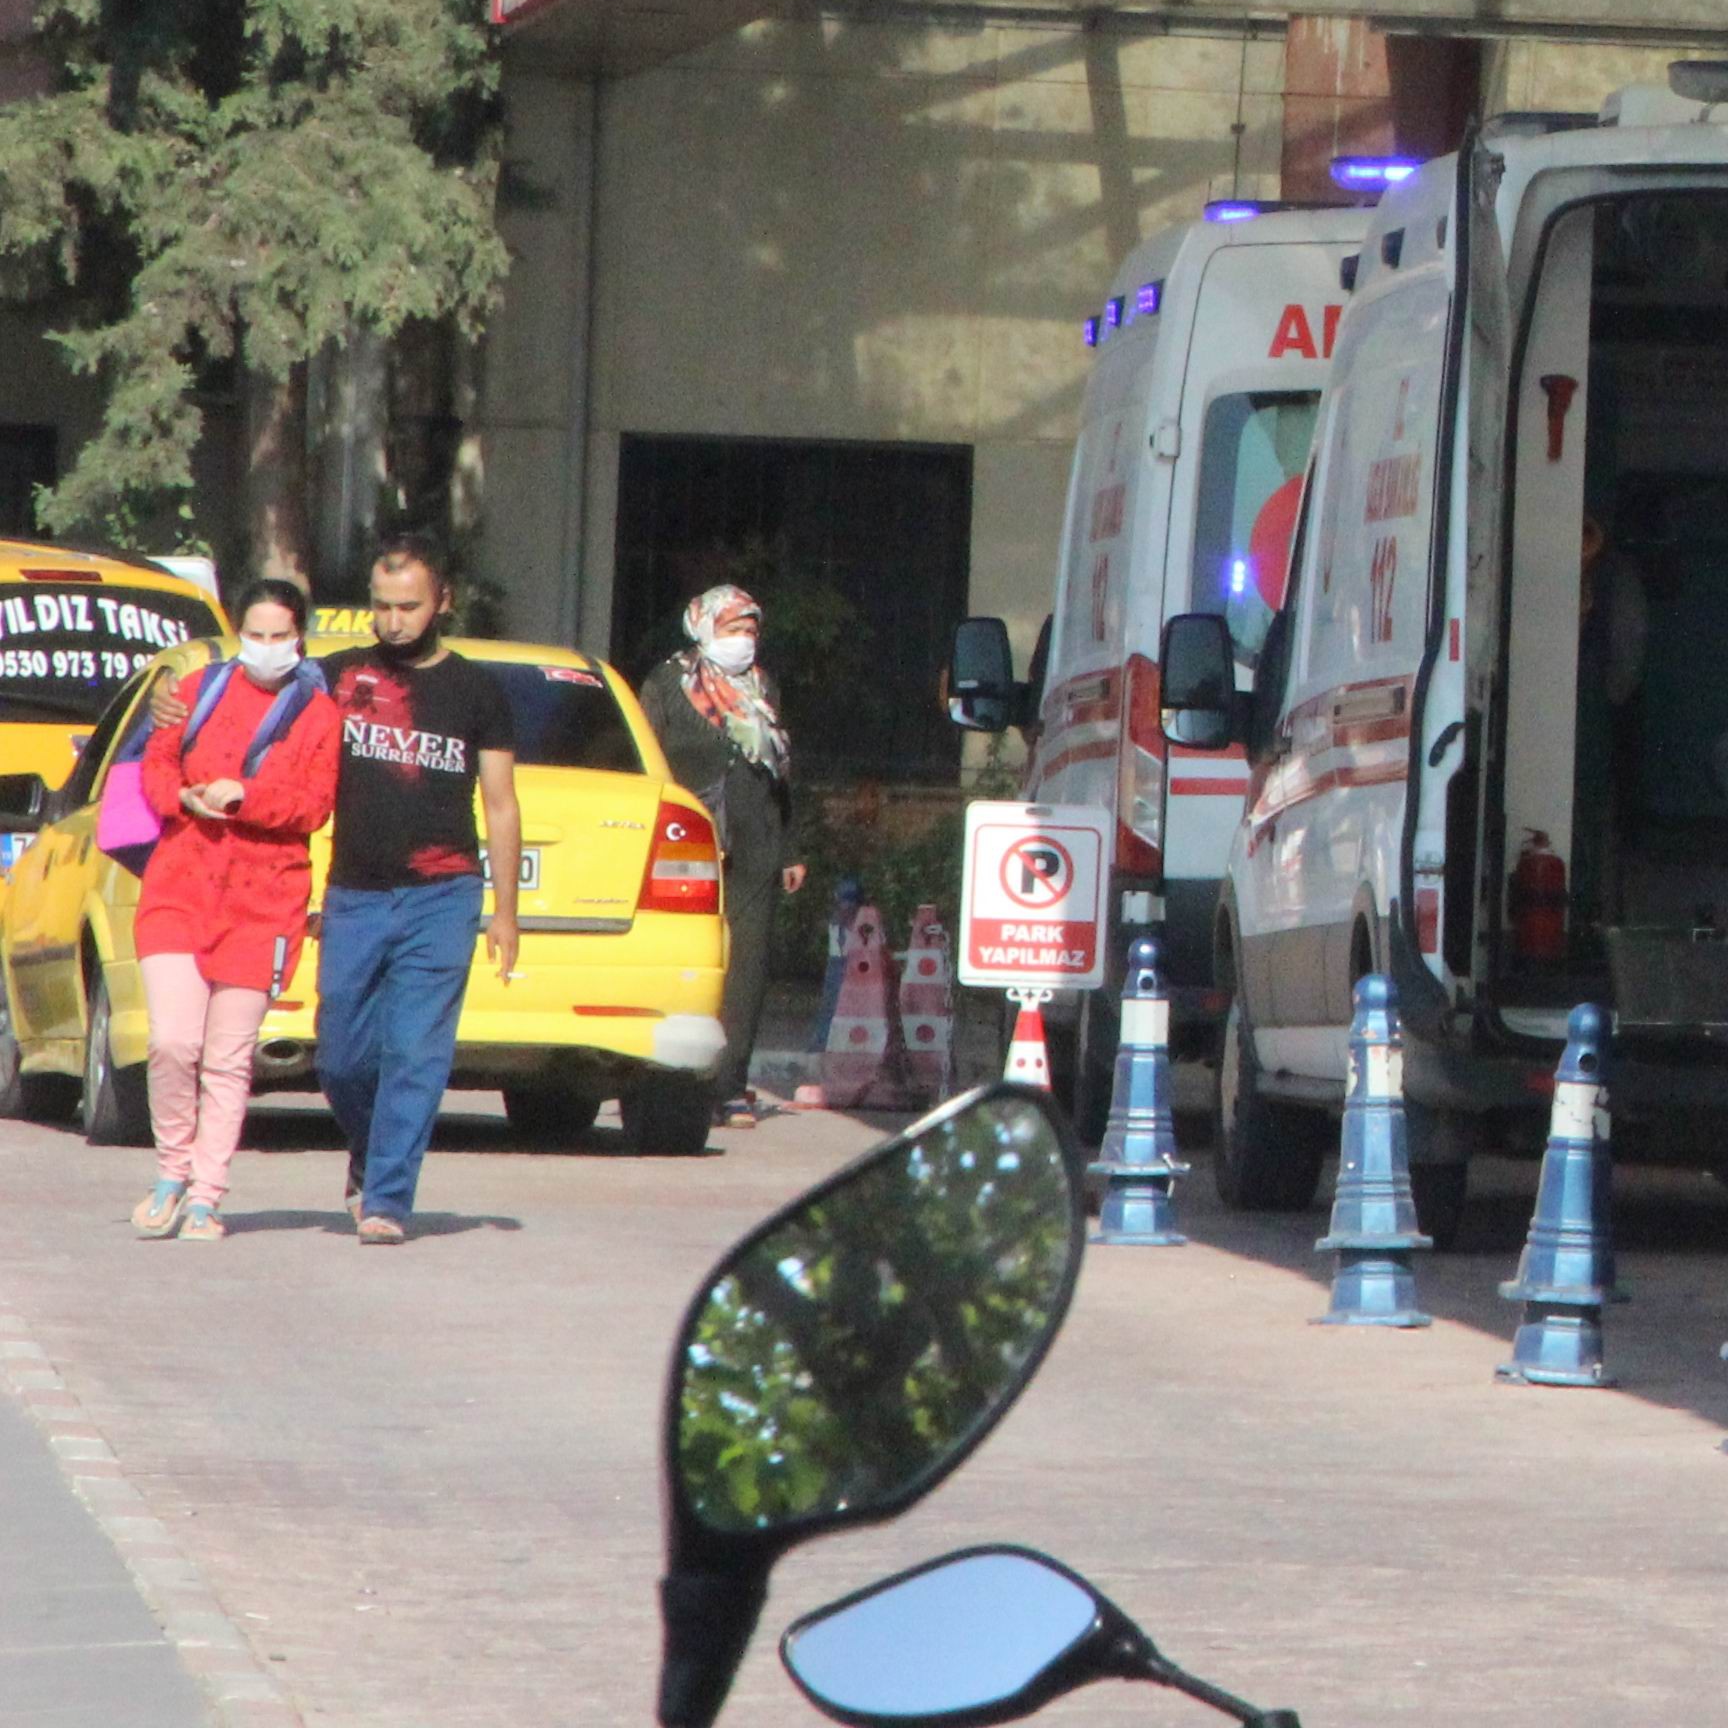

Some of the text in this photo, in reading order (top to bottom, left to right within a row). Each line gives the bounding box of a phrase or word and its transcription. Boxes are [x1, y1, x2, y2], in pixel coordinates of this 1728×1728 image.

[0, 593, 190, 649] ILDIZ TAKSİ
[52, 651, 96, 679] 973
[101, 651, 129, 679] 79
[343, 719, 467, 761] NEVER
[350, 742, 467, 774] SURRENDER
[1001, 924, 1065, 944] PARK
[978, 946, 1085, 967] YAPILMAZ
